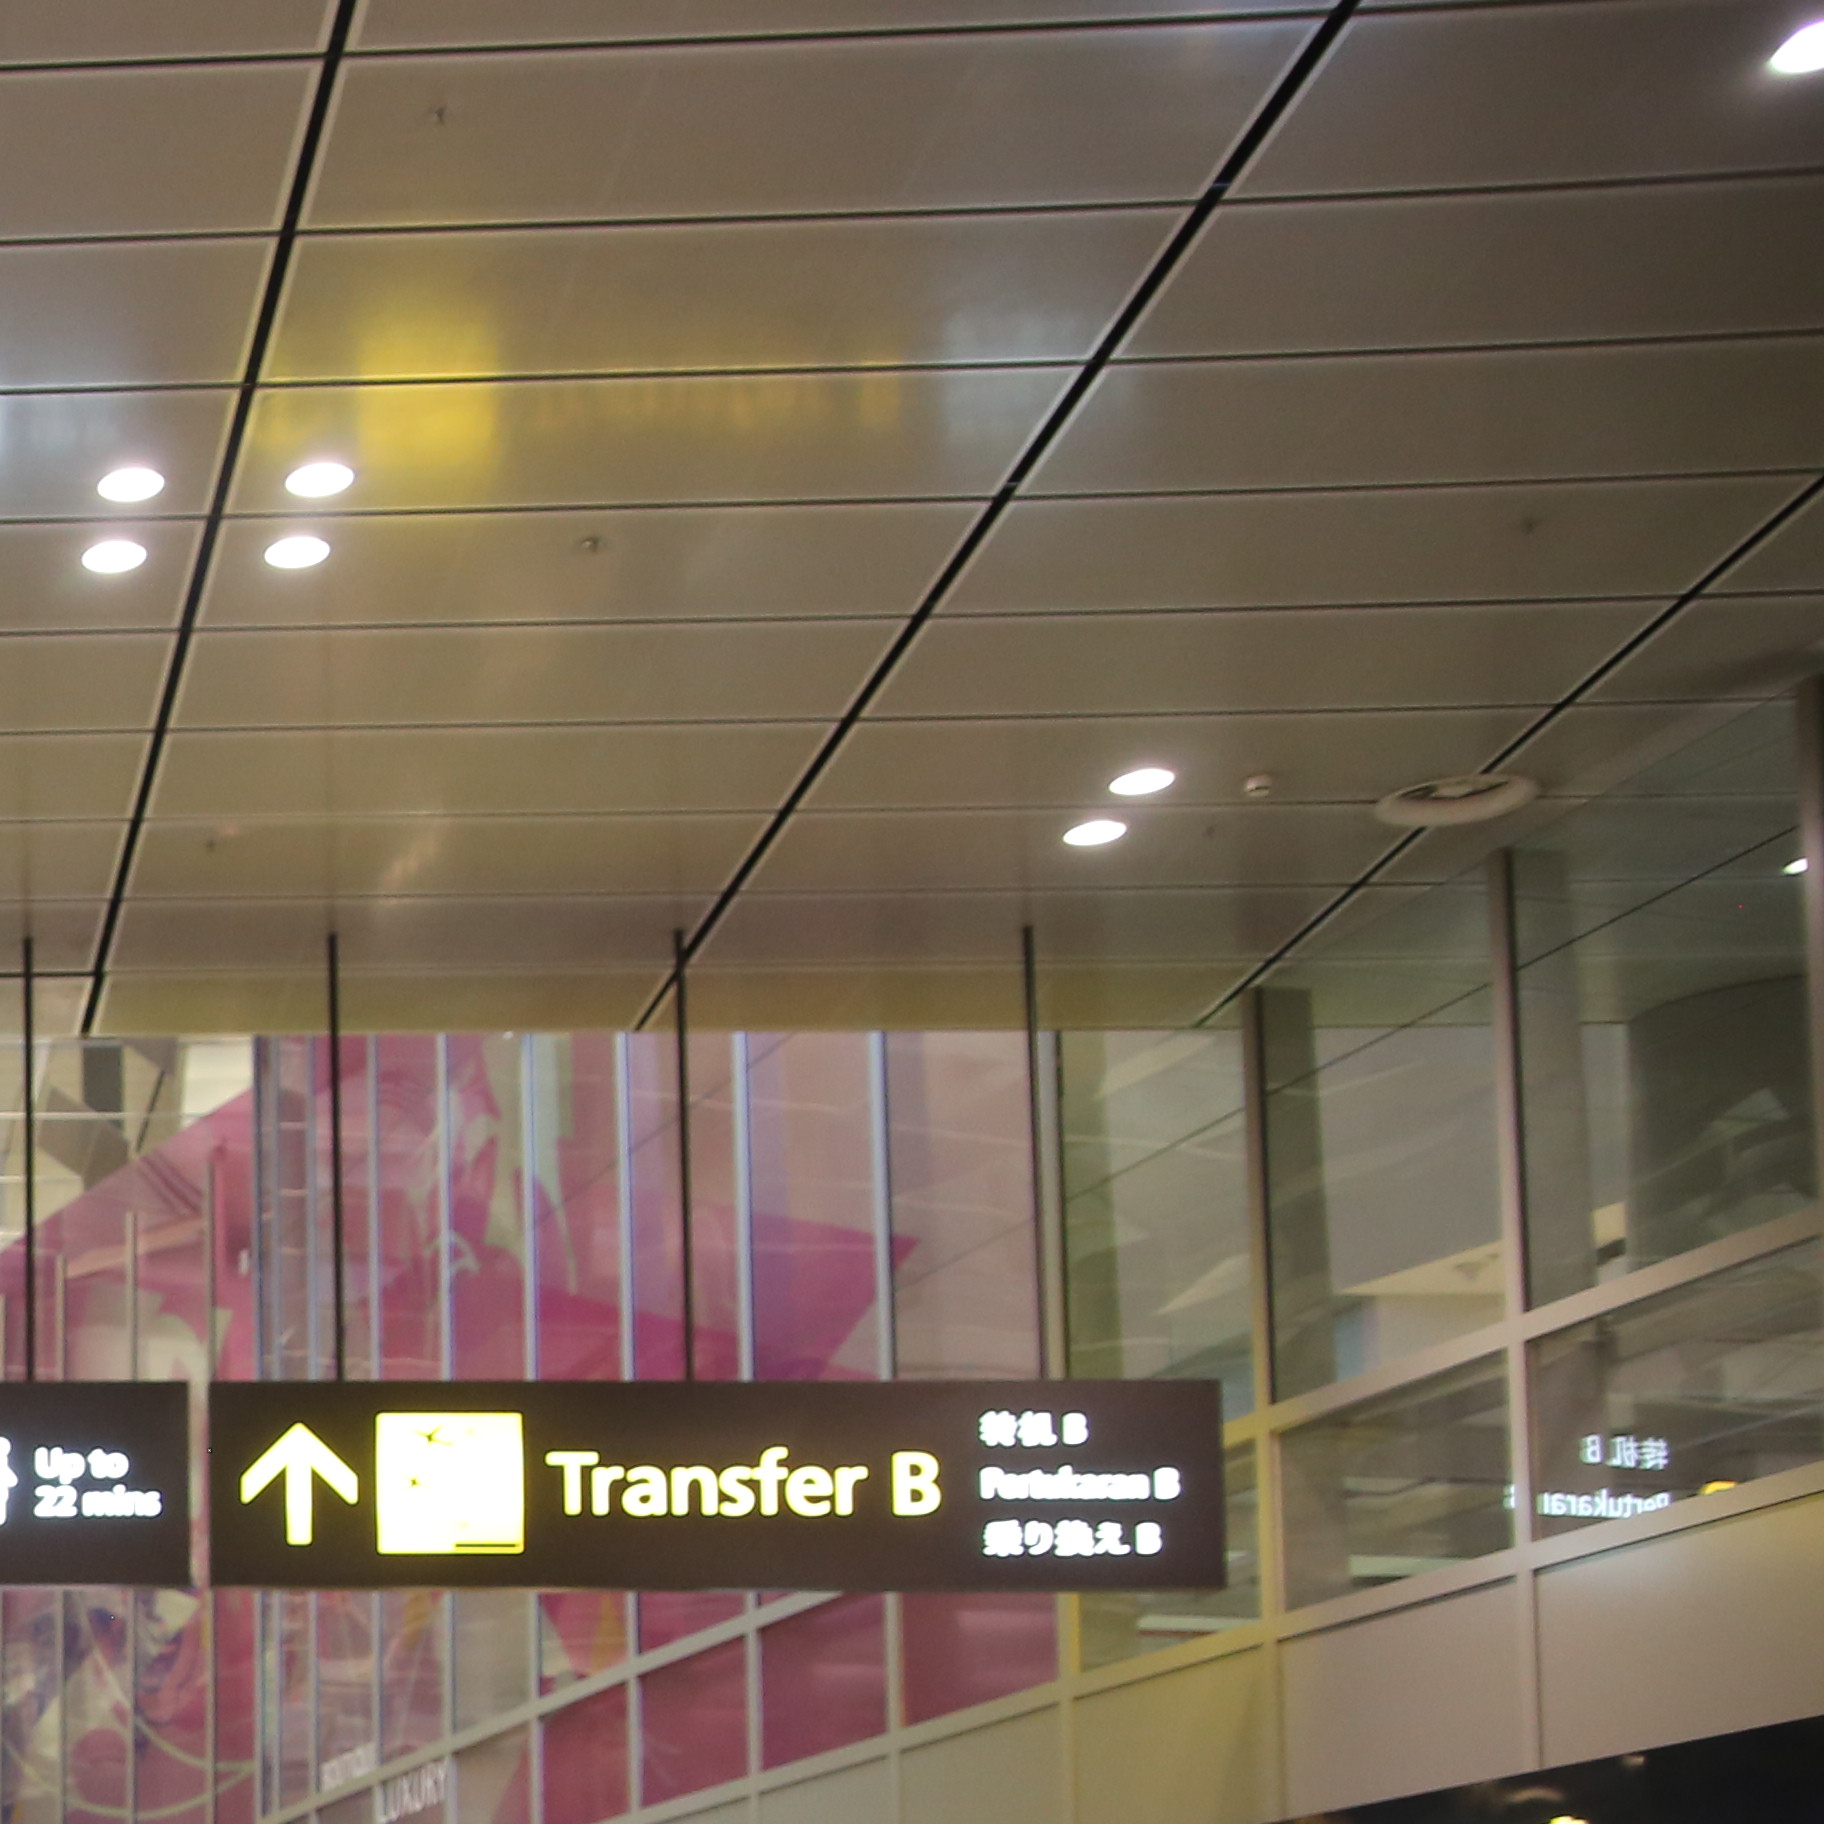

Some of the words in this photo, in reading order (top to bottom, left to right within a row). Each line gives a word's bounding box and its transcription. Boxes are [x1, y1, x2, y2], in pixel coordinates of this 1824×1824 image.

[1061, 1412, 1090, 1446] B
[34, 1446, 86, 1485] Up
[86, 1448, 130, 1479] to
[544, 1445, 869, 1518] Transfer
[891, 1450, 942, 1517] B
[34, 1484, 78, 1517] 22
[81, 1483, 162, 1517] mins
[1153, 1466, 1181, 1501] B
[1134, 1521, 1163, 1556] B
